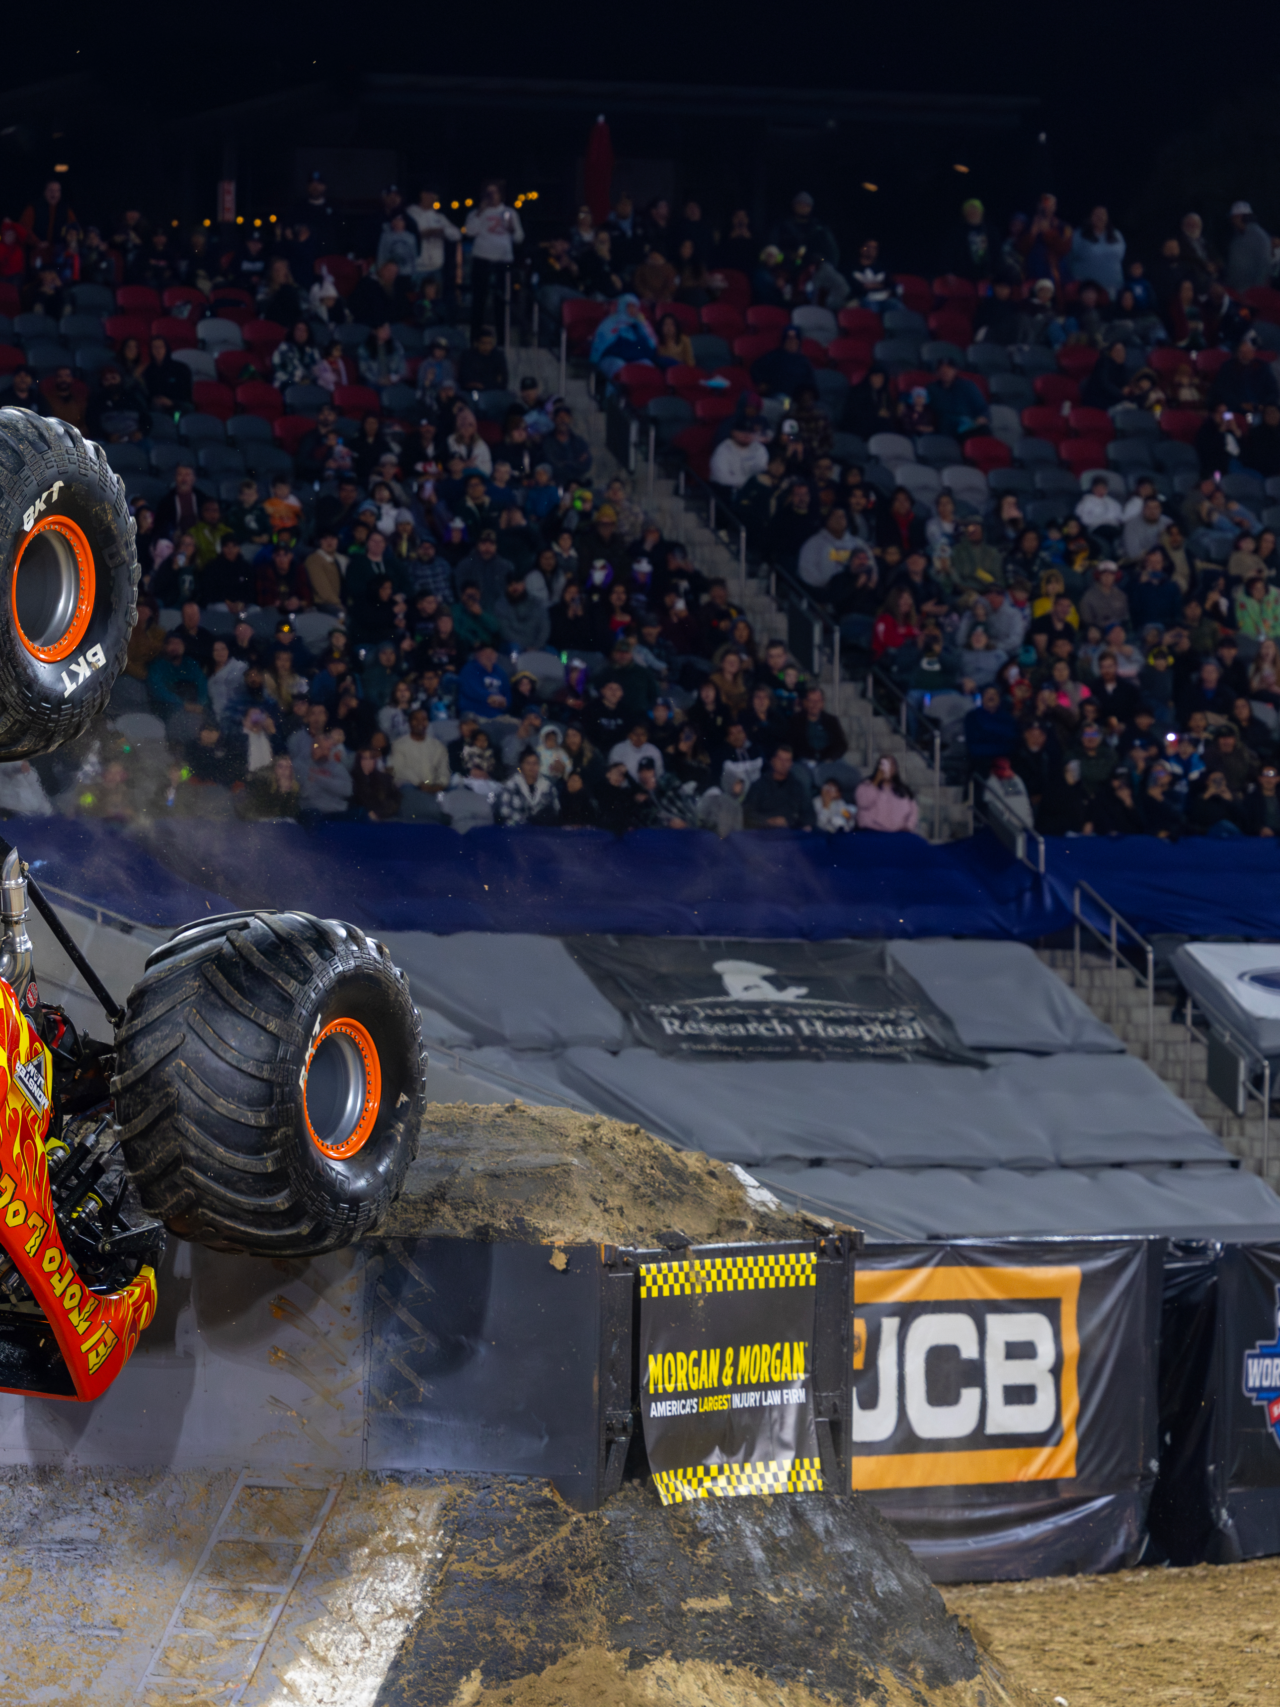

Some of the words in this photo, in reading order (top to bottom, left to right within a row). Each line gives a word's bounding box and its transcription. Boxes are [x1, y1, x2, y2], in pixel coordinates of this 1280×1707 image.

[23, 480, 64, 532] BKT
[61, 643, 107, 698] BKT
[660, 1016, 794, 1036] Research
[797, 1018, 926, 1042] Hospital
[15, 1059, 50, 1110] MONSTER
[26, 1062, 45, 1086] JAM
[648, 1348, 721, 1394] MORGAN
[722, 1346, 734, 1387] &
[737, 1341, 805, 1386] MORGAN
[852, 1313, 1056, 1442] JCB
[650, 1397, 698, 1418] AMERICA'S
[698, 1394, 732, 1413] LARGEST
[732, 1391, 760, 1409] INJURY
[762, 1389, 783, 1405] LAW
[783, 1388, 806, 1404] FIRM
